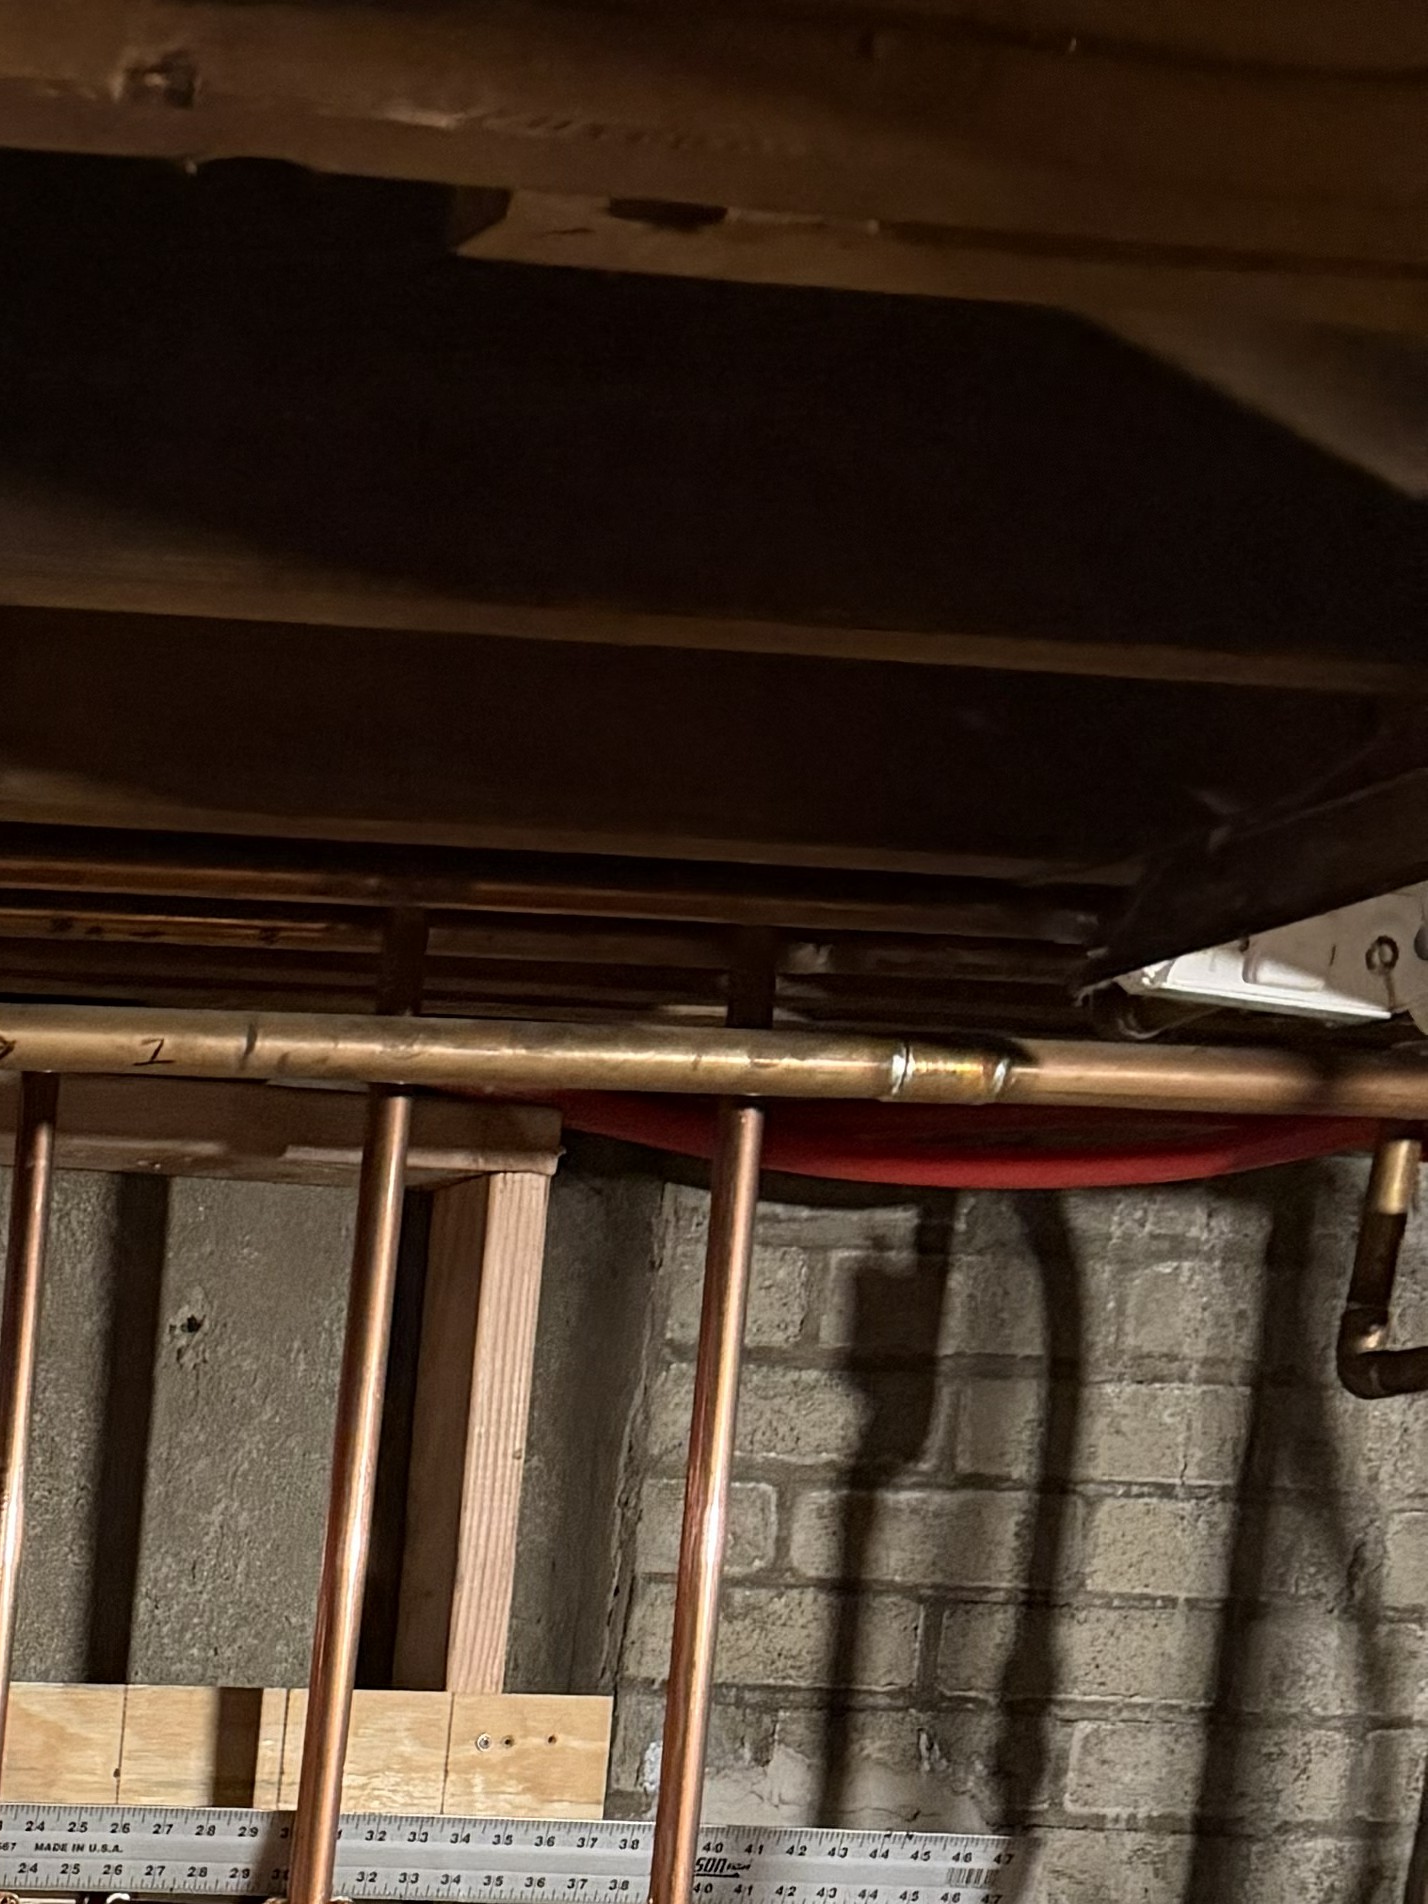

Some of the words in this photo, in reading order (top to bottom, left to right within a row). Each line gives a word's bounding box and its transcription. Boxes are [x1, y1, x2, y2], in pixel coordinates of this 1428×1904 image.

[25, 1821, 45, 1832] 24
[67, 1822, 88, 1833] 25
[110, 1823, 131, 1834] 26
[152, 1823, 173, 1835] 27
[195, 1825, 216, 1836] 28
[238, 1826, 258, 1838] 29
[365, 1830, 387, 1841] 32
[407, 1831, 429, 1843] 33
[450, 1832, 471, 1844] 34
[492, 1833, 513, 1845] 35
[534, 1835, 555, 1847] 36
[577, 1836, 598, 1848] 37
[619, 1838, 640, 1850] 38
[702, 1842, 724, 1853] 40
[744, 1843, 764, 1855] 41
[786, 1845, 808, 1856] 42
[869, 1848, 890, 1860] 44
[35, 1842, 68, 1853] MADE
[71, 1843, 84, 1853] IN
[18, 1862, 38, 1874] 24
[60, 1863, 81, 1875] 25
[102, 1864, 123, 1875] 26
[144, 1865, 165, 1876] 27
[187, 1866, 208, 1878] 28
[229, 1867, 250, 1879] 29
[356, 1871, 378, 1882] 32
[398, 1872, 420, 1884] 33
[440, 1873, 461, 1885] 34
[483, 1875, 504, 1887] 35
[524, 1876, 546, 1888] 36
[567, 1877, 588, 1889] 37
[609, 1879, 629, 1891] 38
[692, 1882, 713, 1894] 40
[733, 1884, 753, 1895] 41
[775, 1885, 796, 1897] 42
[858, 1889, 879, 1901] 44
